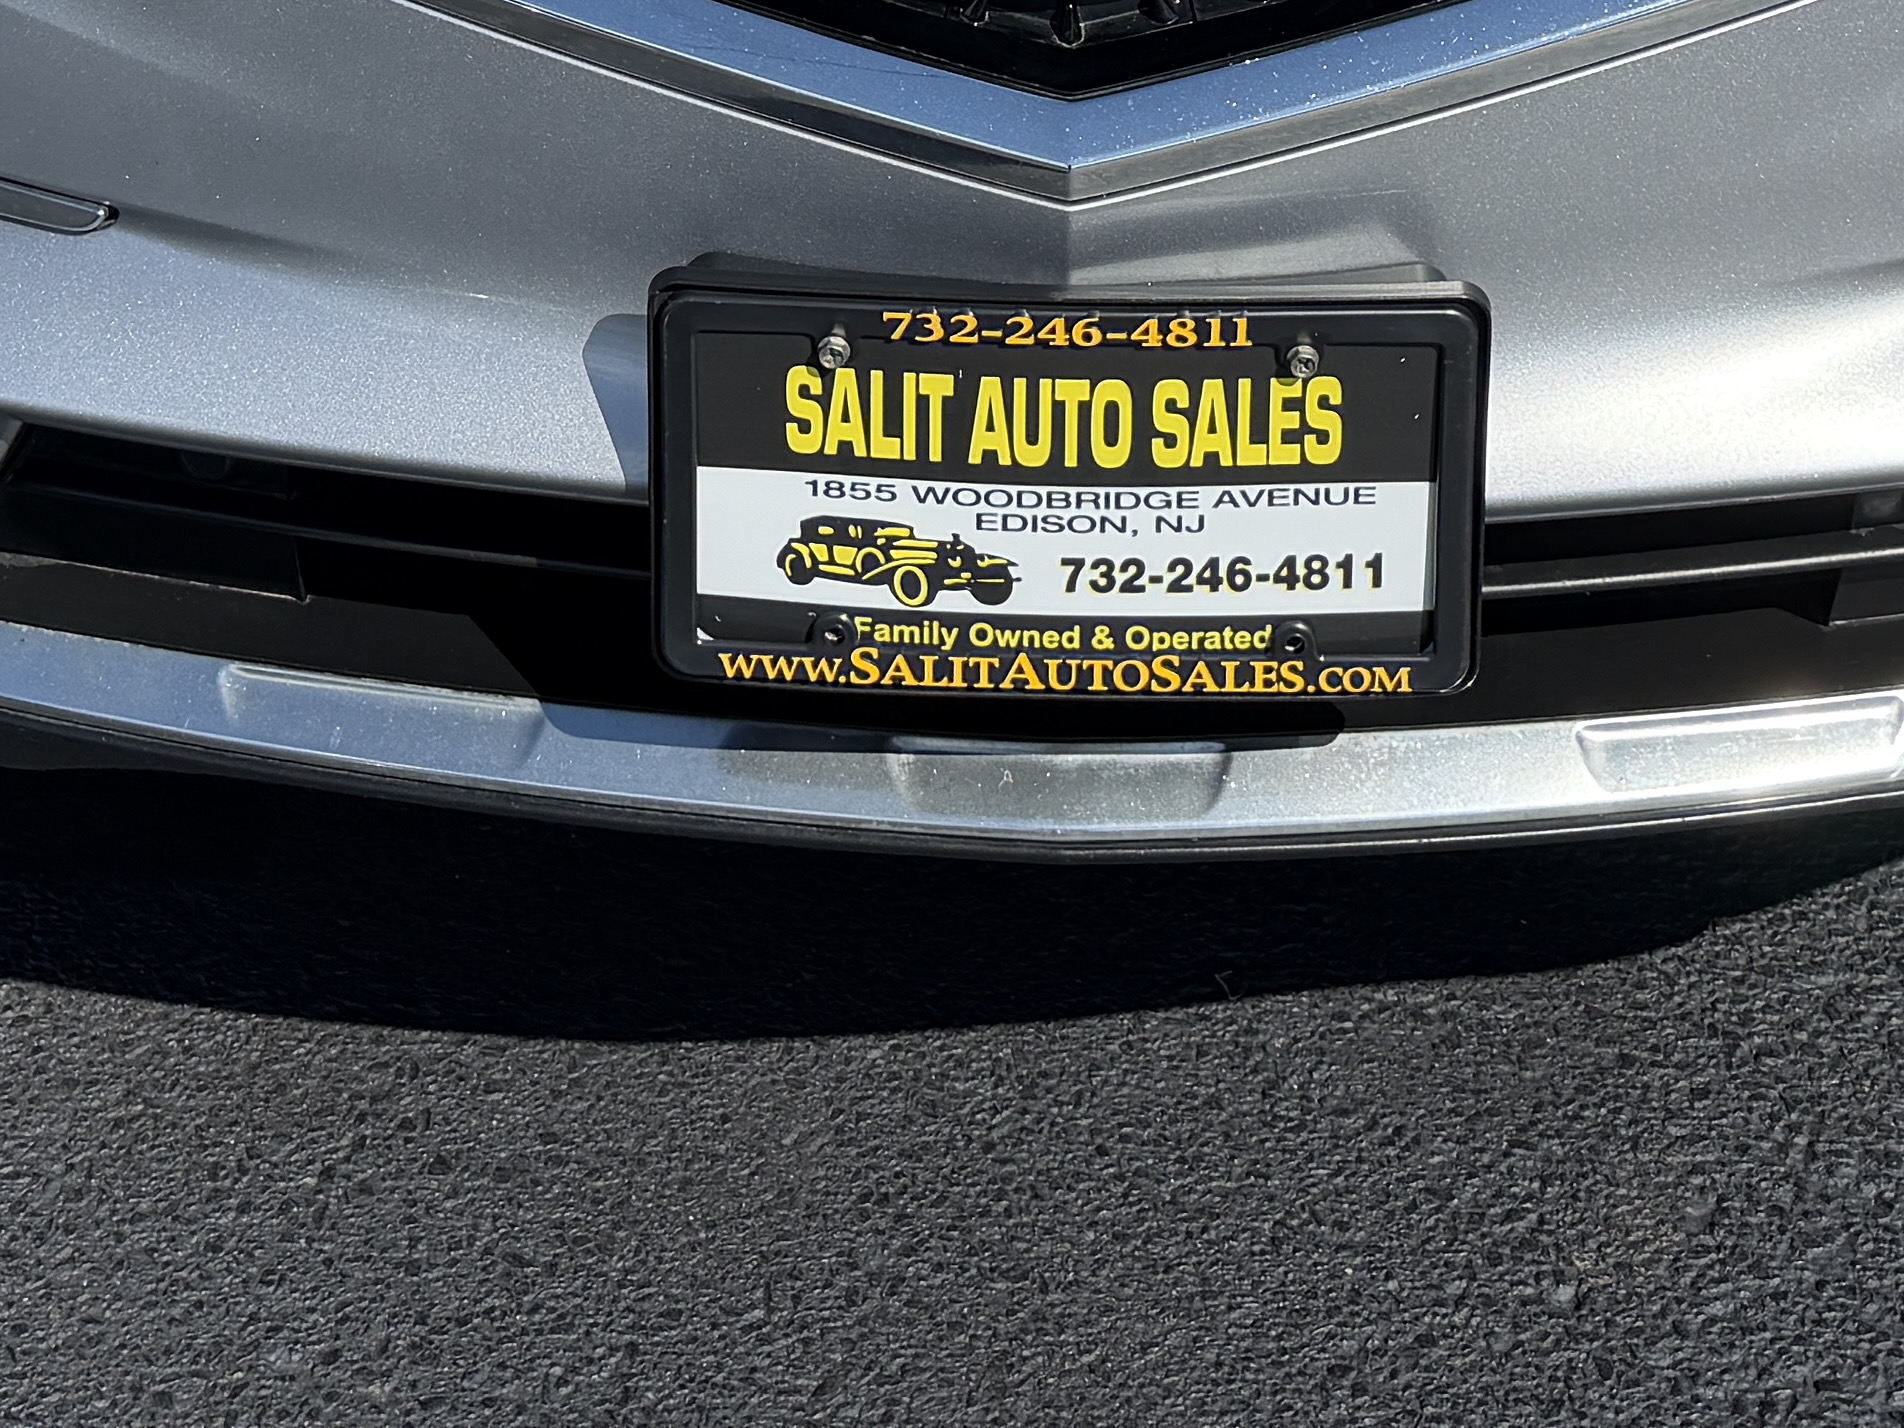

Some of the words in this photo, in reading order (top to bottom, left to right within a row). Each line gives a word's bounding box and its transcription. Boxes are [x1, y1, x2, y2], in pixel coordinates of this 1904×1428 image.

[882, 311, 1253, 348] 732-246-4811
[785, 364, 955, 463] SALIT
[967, 375, 1133, 469] AUTO
[1151, 375, 1343, 468] SALES
[804, 479, 897, 503] 1855
[911, 484, 1200, 511] WOODBRIDGE
[1212, 485, 1377, 510] AVENUE
[975, 512, 1138, 537] EDISON,
[1154, 514, 1206, 534] NJ
[1060, 552, 1384, 594] 732-246-4811
[854, 616, 960, 651] Family
[969, 622, 1080, 649] Owned
[1091, 625, 1115, 650] &
[1125, 624, 1273, 652] Operated
